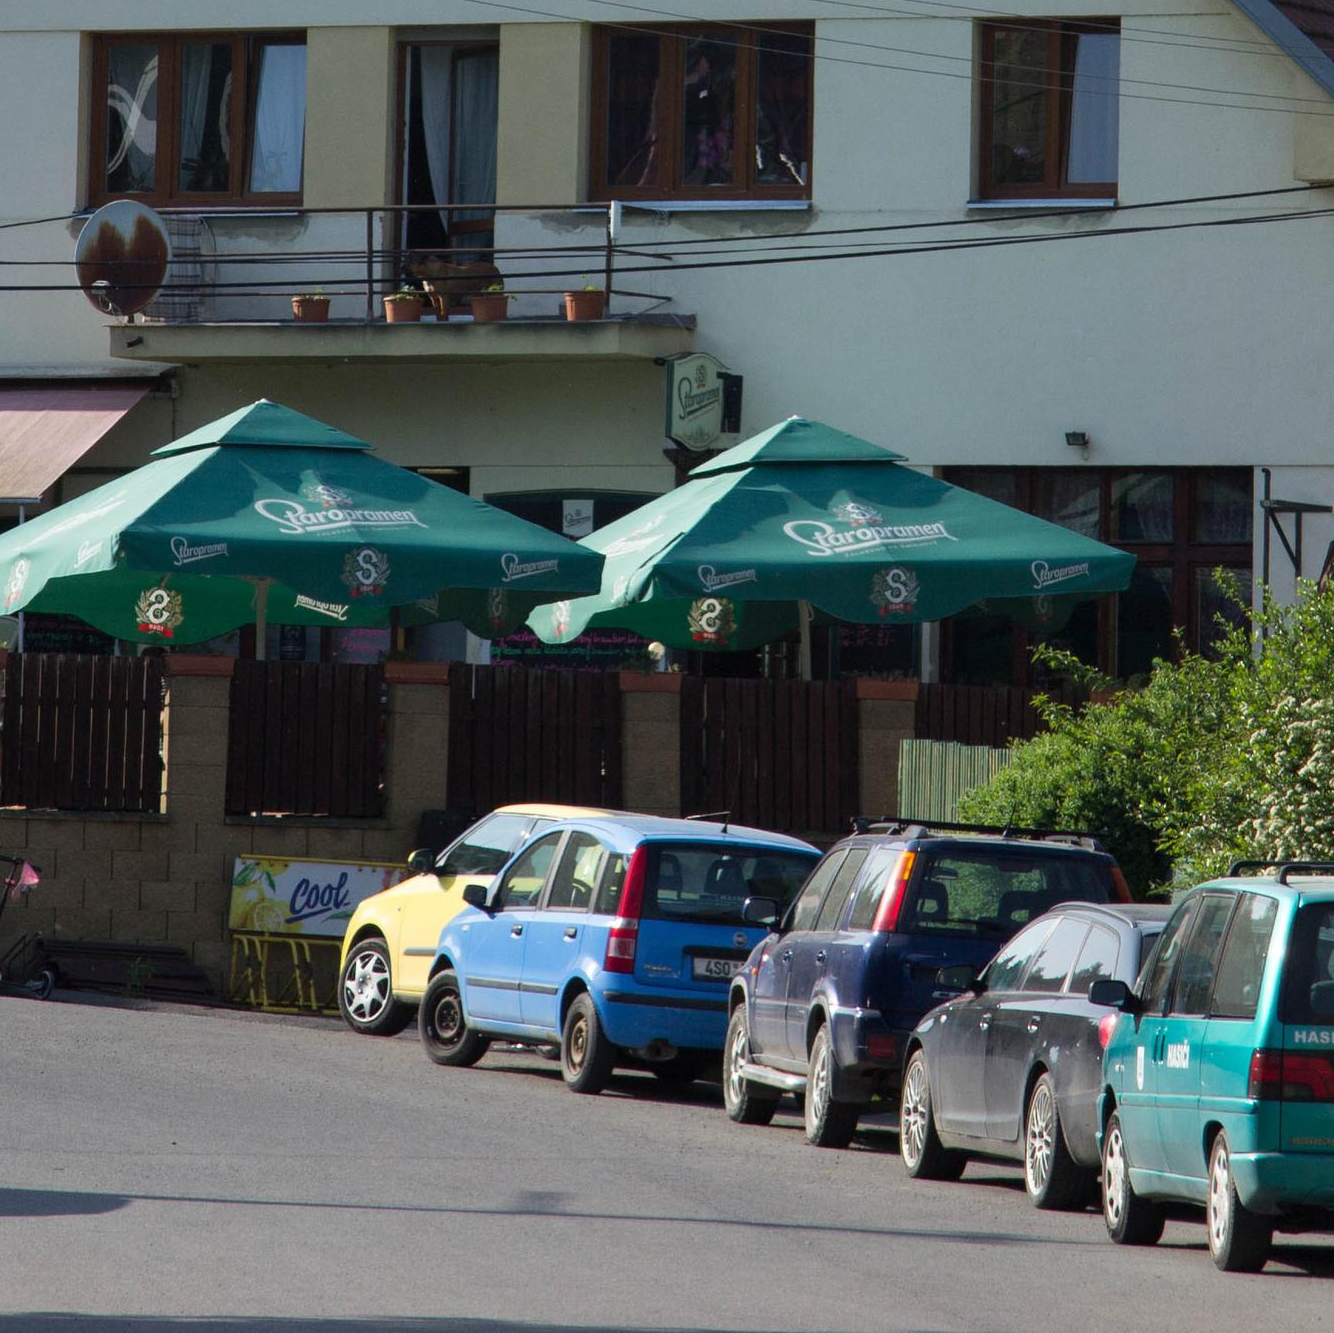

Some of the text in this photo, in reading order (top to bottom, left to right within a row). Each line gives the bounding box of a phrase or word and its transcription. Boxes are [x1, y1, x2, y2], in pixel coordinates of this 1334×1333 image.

[254, 499, 429, 534] Staropramen
[171, 536, 229, 565] Staropramen
[783, 520, 959, 556] Staropramen
[289, 872, 350, 916] Cool
